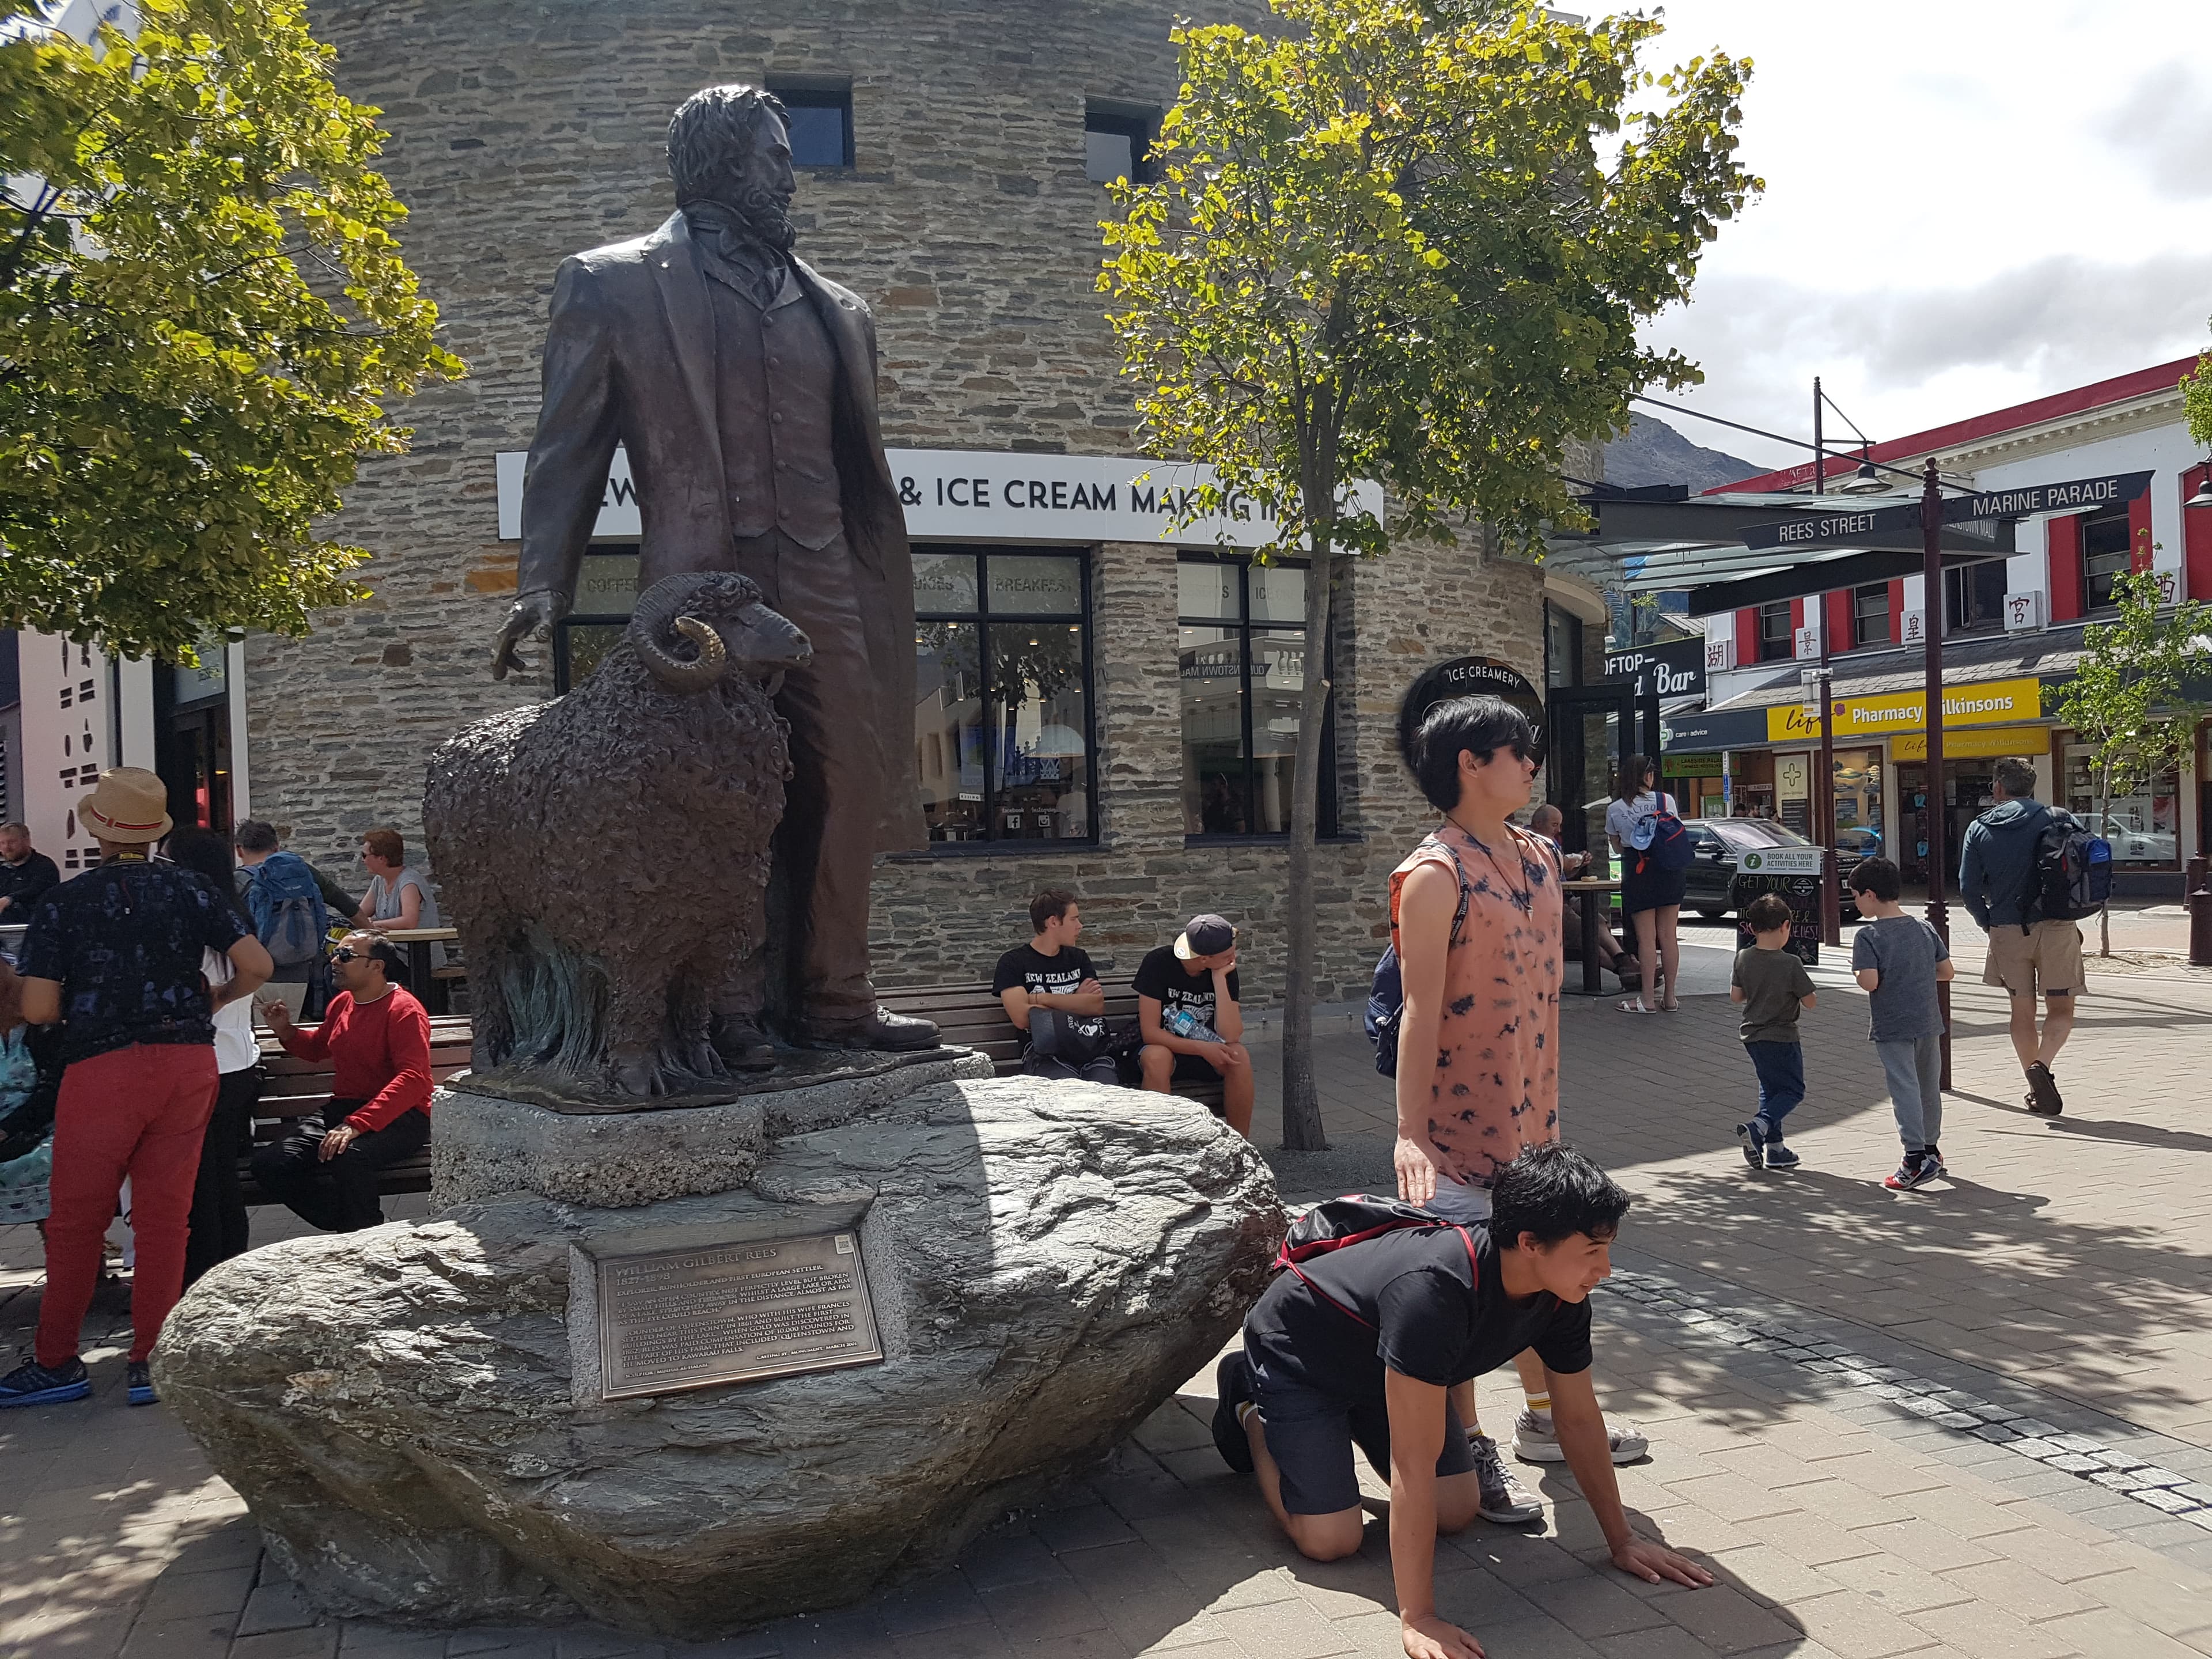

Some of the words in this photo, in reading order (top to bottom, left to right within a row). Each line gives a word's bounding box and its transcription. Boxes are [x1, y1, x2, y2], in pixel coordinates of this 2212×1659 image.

[899, 476, 922, 506] &
[937, 478, 990, 507] ICE
[1003, 479, 1116, 511] CREAM
[1972, 491, 2041, 516] MARINE
[2047, 479, 2118, 506] PARADE
[1779, 522, 1814, 542] REES
[1820, 513, 1876, 537] STREET
[1980, 520, 1995, 539] MALL
[1905, 614, 1924, 641] 皇
[1798, 631, 1817, 655] 景
[1707, 643, 1724, 668] 湖
[1448, 668, 1465, 683] ICE
[1468, 665, 1520, 688] CREAMERY
[1653, 662, 1696, 694] Bar
[1853, 705, 1923, 724] Pharmacy
[1942, 696, 2014, 715] ilkinsons
[1690, 729, 1708, 737] advice
[1738, 874, 1763, 889] GET
[1765, 875, 1793, 893] YOUR
[1025, 972, 1043, 983] NEW
[616, 1260, 680, 1277] WILLIAM
[683, 1252, 741, 1268] GILBERT
[745, 1248, 777, 1260] REES
[751, 1268, 790, 1279] EUROPEAN
[791, 1264, 823, 1273] SETTLER
[739, 1289, 770, 1297] WHILST
[740, 1281, 778, 1291] PERFECTLY
[781, 1278, 801, 1286] LEVEL
[819, 1272, 849, 1281] BROKEN
[796, 1287, 826, 1296] ALMOST
[661, 1311, 690, 1320] COULD
[737, 1313, 757, 1321] WHO
[817, 1301, 850, 1310] FRANCES
[620, 1334, 654, 1343] SETTLED
[656, 1330, 678, 1338] NEAR
[700, 1324, 725, 1332] POINT
[622, 1338, 666, 1349] BUILDINGS
[722, 1327, 748, 1335] WHEN
[749, 1324, 772, 1332] GOLD
[791, 1315, 839, 1326] DISCOVERED
[700, 1331, 763, 1344] COMPENSATION
[801, 1321, 833, 1331] POUNDS
[622, 1354, 639, 1362] THE
[691, 1344, 712, 1352] FARM
[713, 1340, 735, 1349] THAT
[736, 1335, 778, 1346] INCLUDED
[780, 1327, 835, 1340] QUEENSTOWN
[636, 1357, 666, 1366] MOVED
[681, 1349, 719, 1359] KAWARAU
